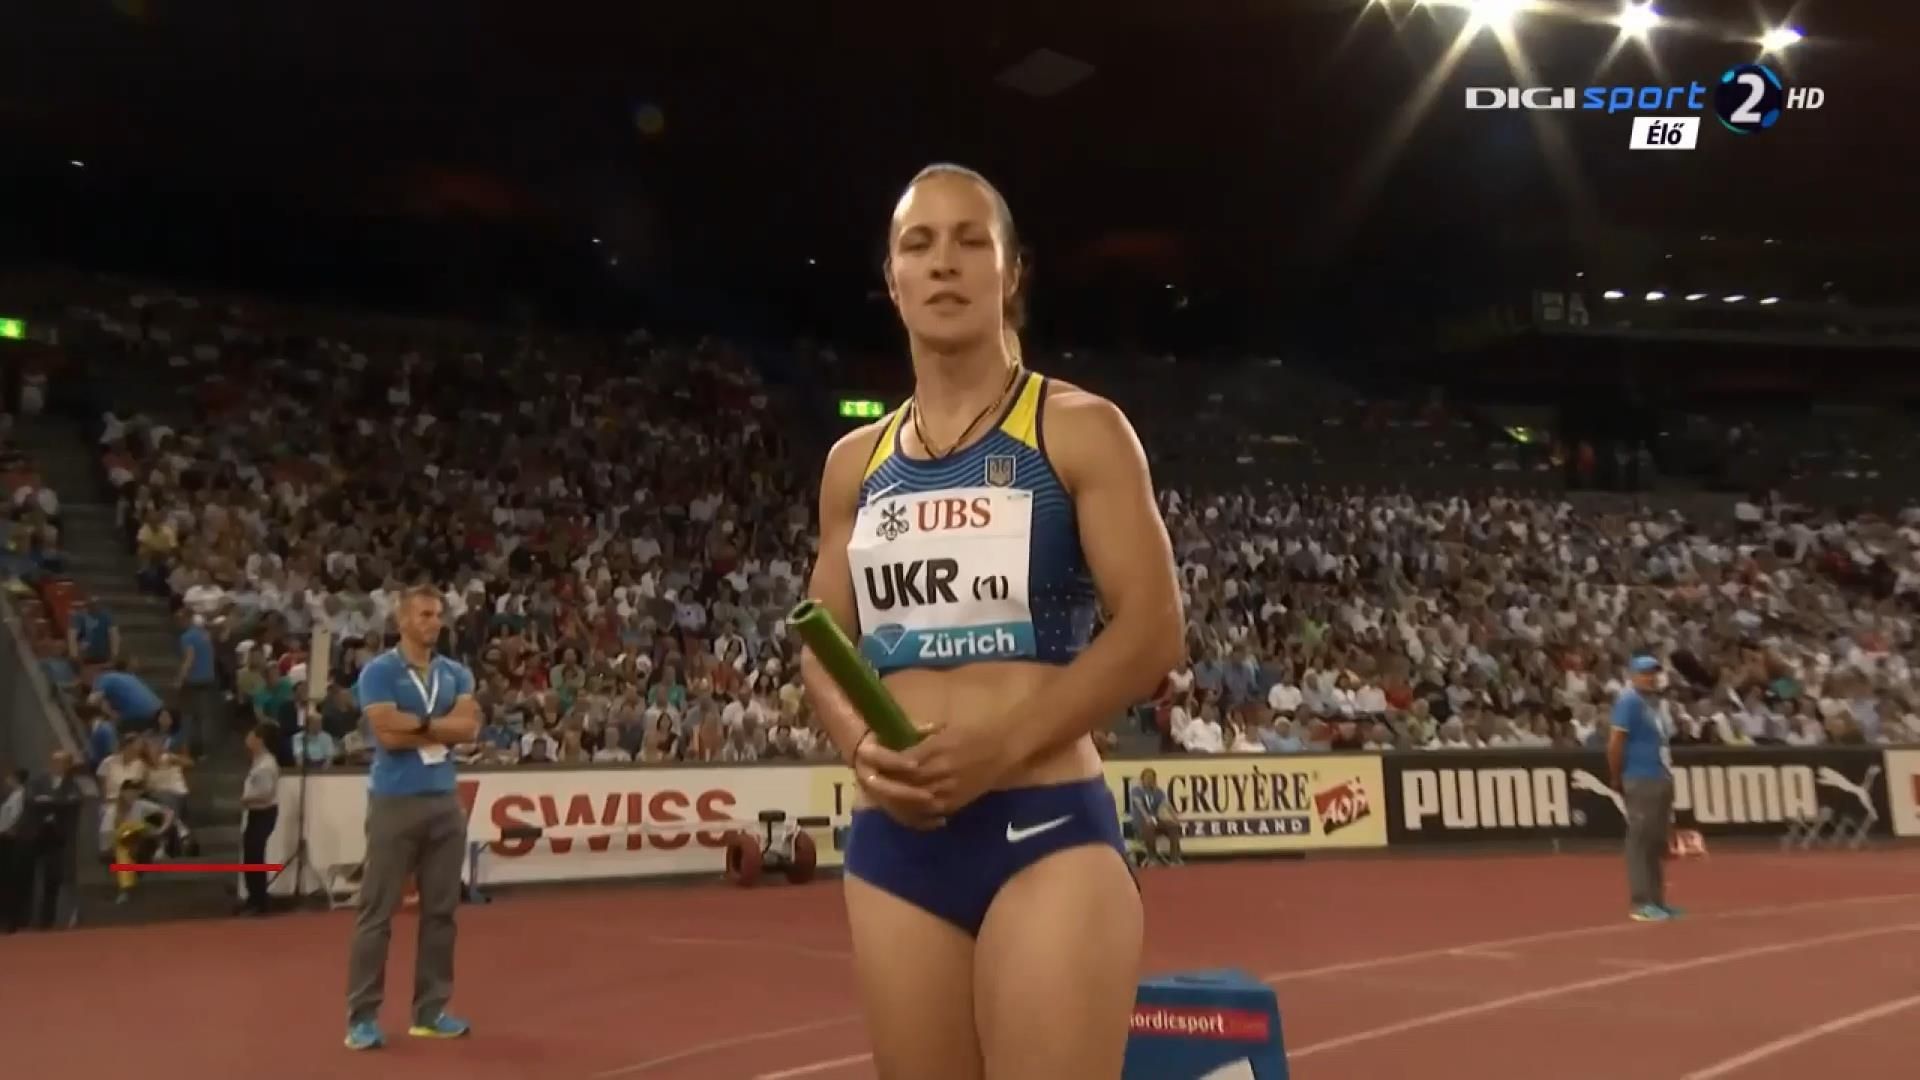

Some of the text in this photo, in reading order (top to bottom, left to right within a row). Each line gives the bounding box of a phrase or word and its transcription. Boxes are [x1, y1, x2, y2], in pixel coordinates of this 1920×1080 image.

[917, 497, 992, 532] UBS
[864, 558, 1009, 610] UKR (1)
[918, 628, 1015, 659] Zürich
[1167, 765, 1311, 814] GRUYÈRE
[1402, 768, 1570, 830] PUMA
[490, 789, 737, 857] SWISS
